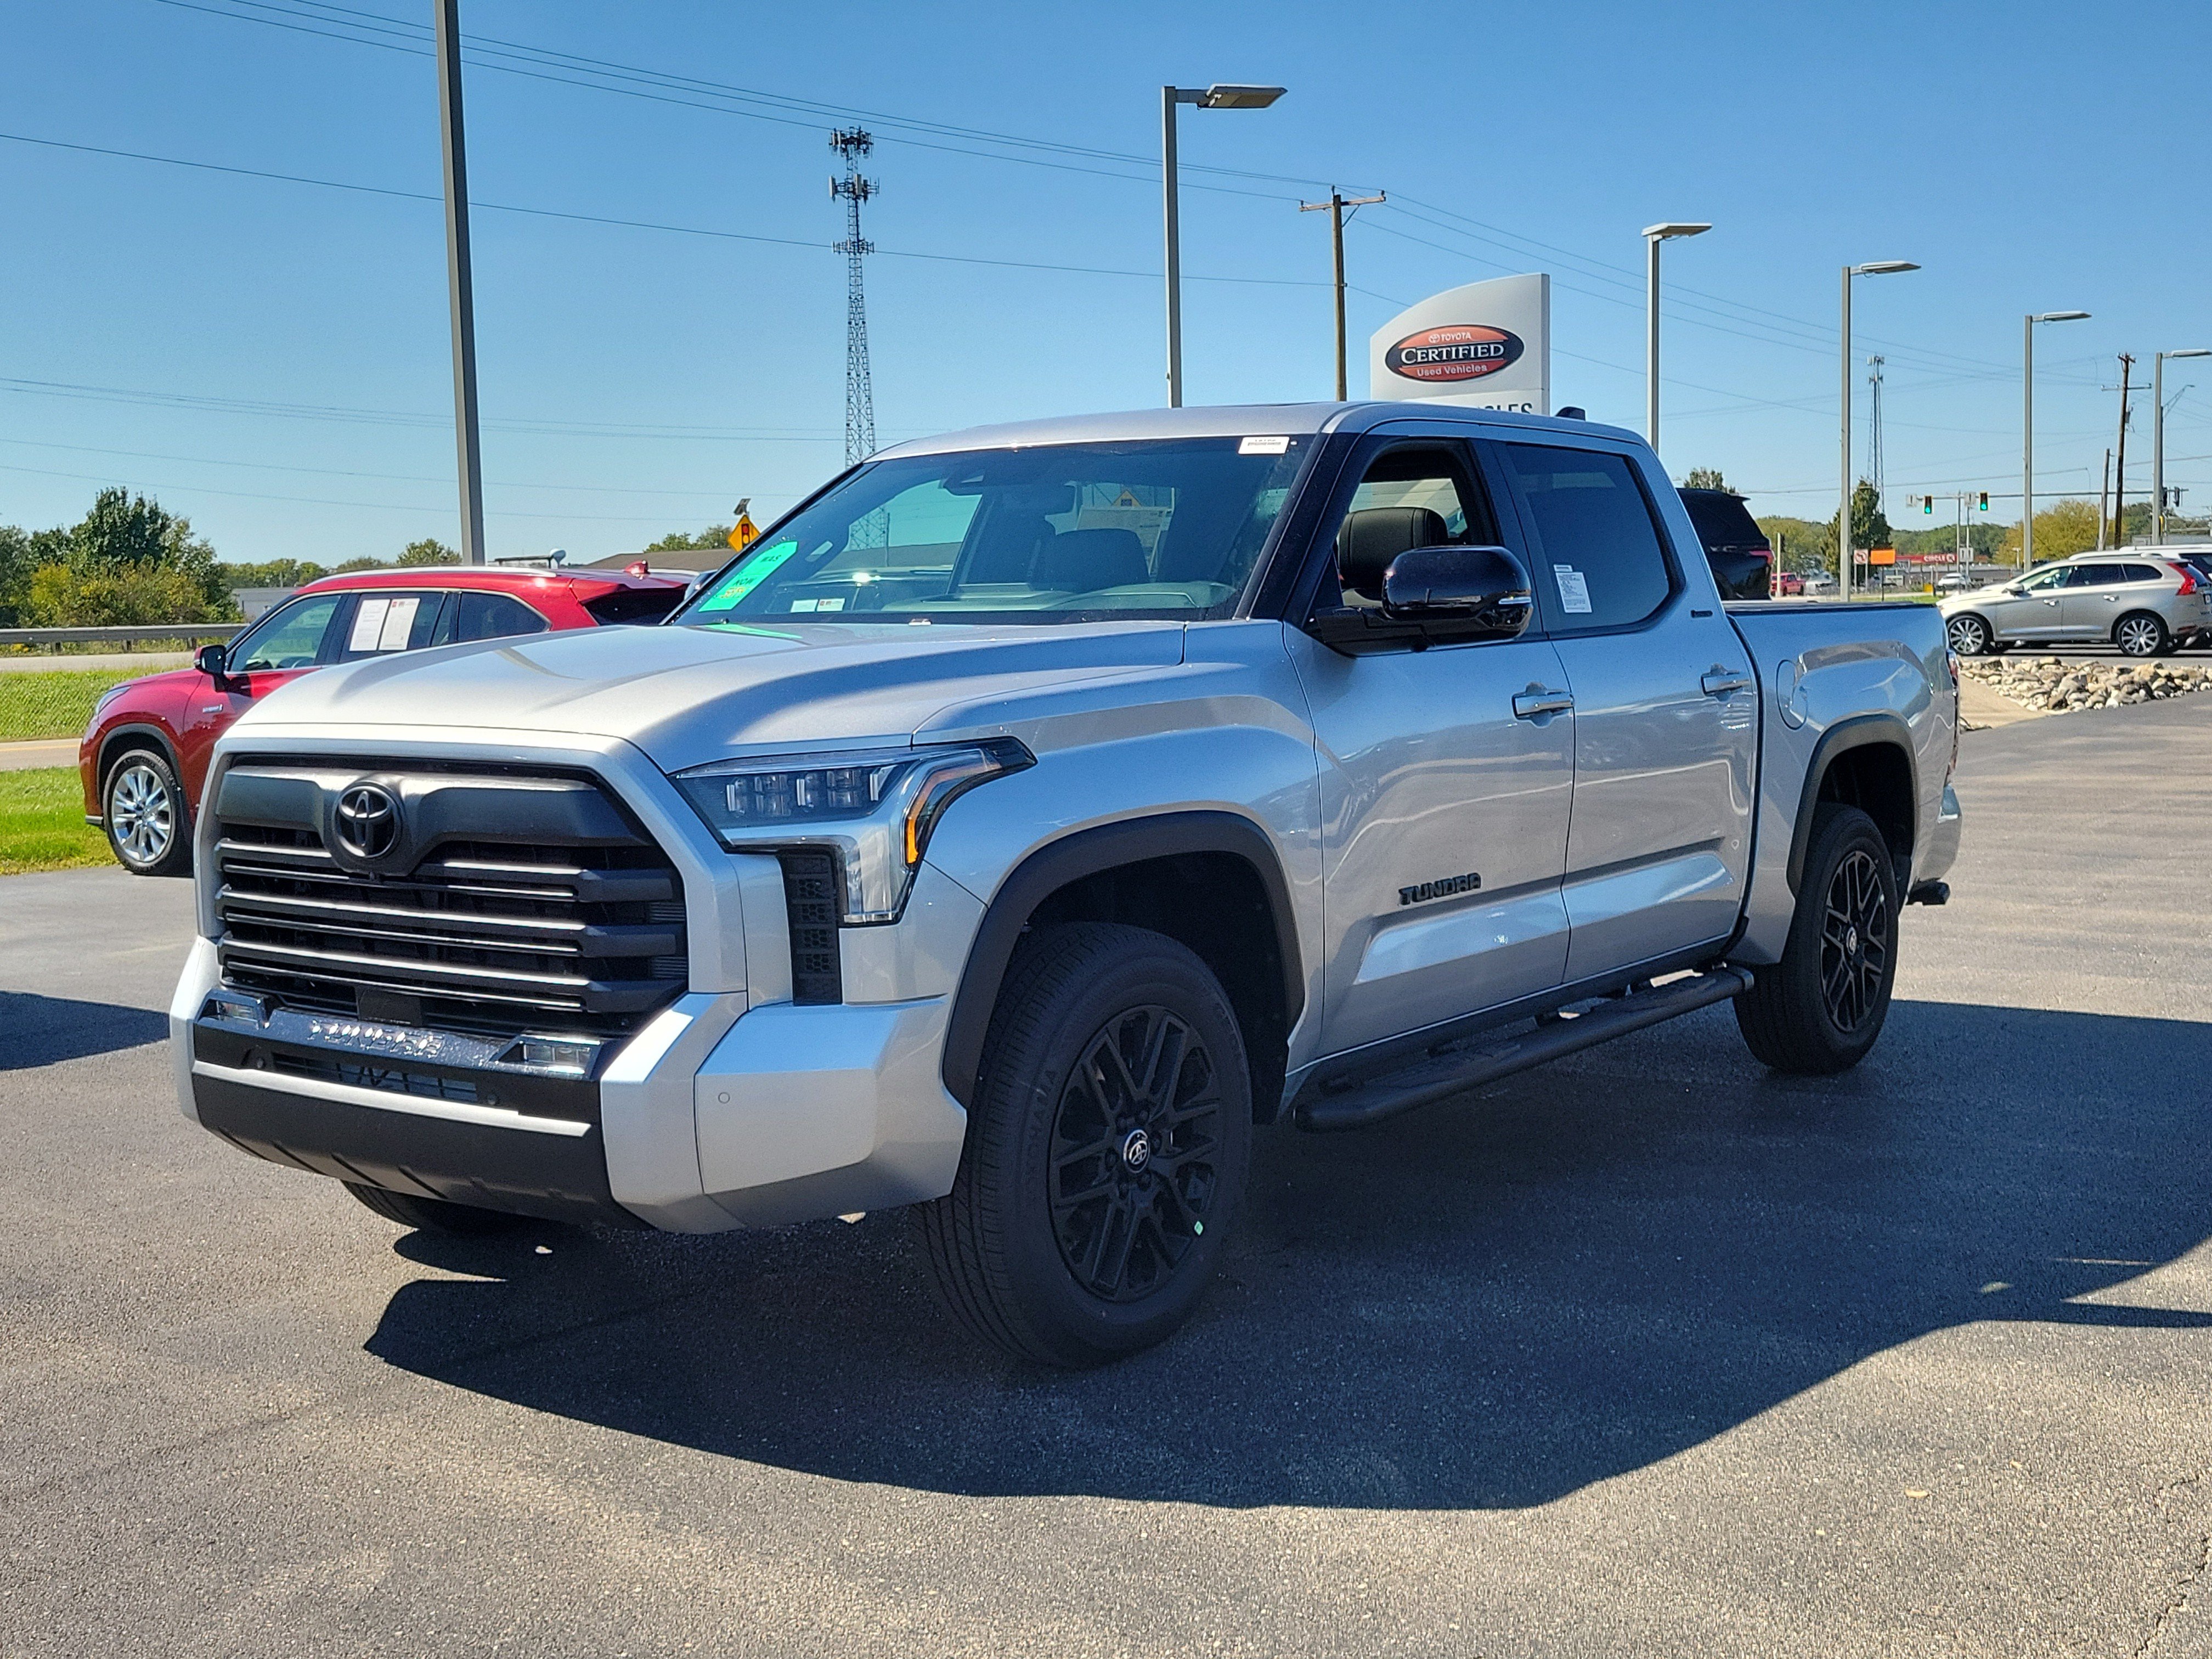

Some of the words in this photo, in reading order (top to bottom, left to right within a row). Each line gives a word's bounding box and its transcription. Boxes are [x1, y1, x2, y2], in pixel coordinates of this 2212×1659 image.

[1440, 331, 1472, 342] TOYOTA
[1401, 343, 1504, 364] CERTIFIED
[1417, 366, 1442, 377] Used
[1444, 364, 1487, 375] Vehicles
[1398, 872, 1482, 905] TUNDRA
